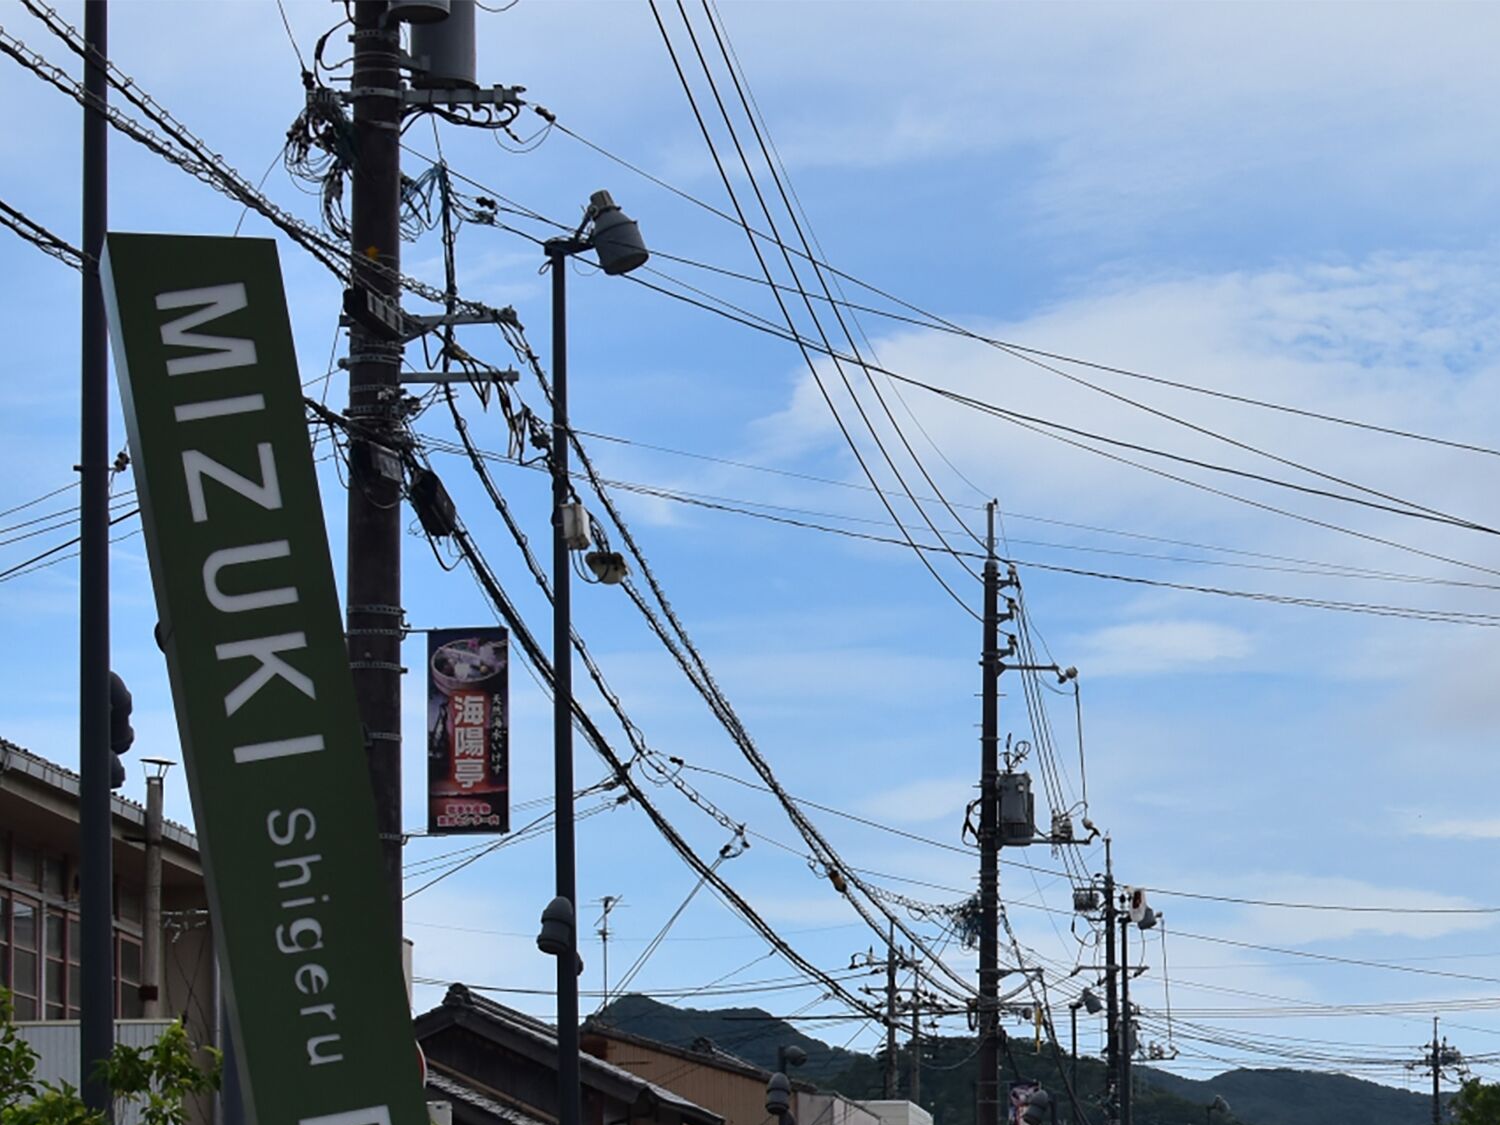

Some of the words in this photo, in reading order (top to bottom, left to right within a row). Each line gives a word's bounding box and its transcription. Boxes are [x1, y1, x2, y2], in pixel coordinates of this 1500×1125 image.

[156, 283, 325, 764] MIZUKI
[268, 809, 342, 1065] Shigeru
[454, 695, 485, 788] 海陽亭
